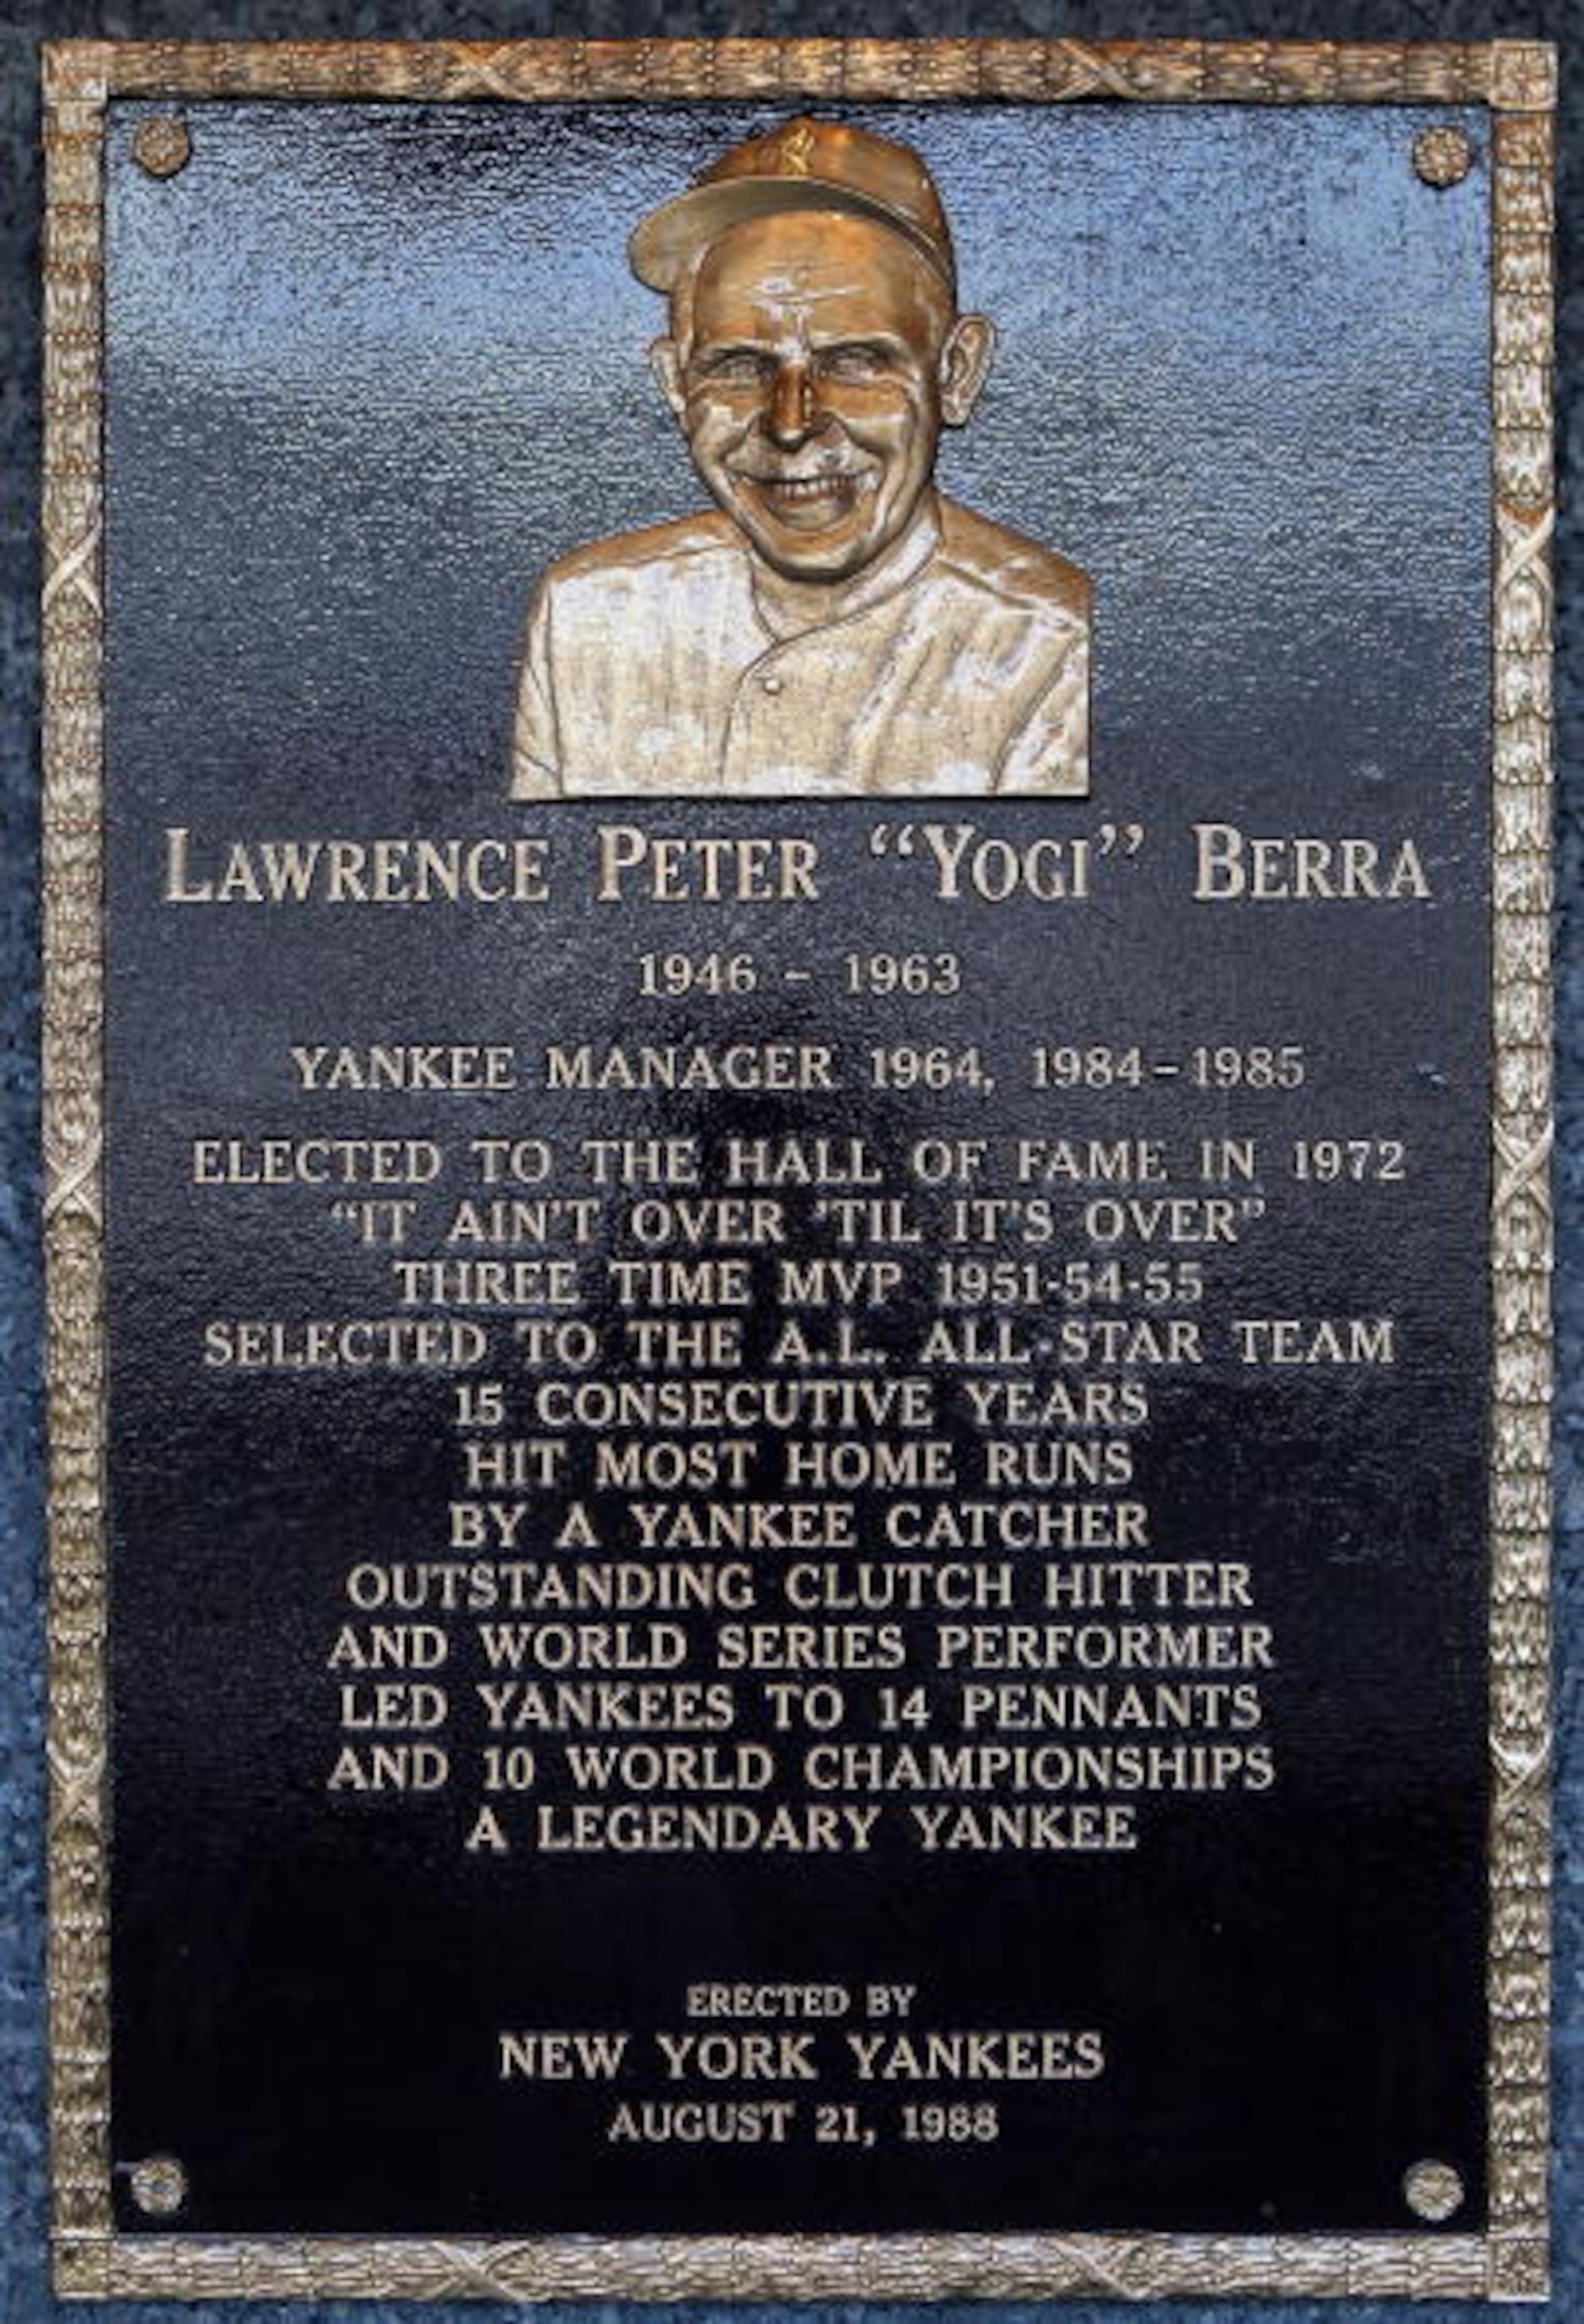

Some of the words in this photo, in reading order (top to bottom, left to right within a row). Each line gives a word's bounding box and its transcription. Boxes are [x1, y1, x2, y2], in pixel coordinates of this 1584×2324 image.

[165, 827, 549, 902] LAWRENCE
[598, 826, 819, 900] PETER
[1194, 824, 1431, 899] BERRA
[639, 953, 756, 995] 1946
[846, 953, 960, 995] 1963
[291, 1046, 516, 1091] YANKEE
[546, 1046, 835, 1090] MANAGER
[871, 1047, 994, 1095] 1964,
[194, 1140, 442, 1184] ELECTED
[470, 1140, 552, 1184] TO
[582, 1139, 697, 1184] THE
[728, 1139, 882, 1185] HALL
[913, 1139, 987, 1185] OF
[1019, 1140, 1167, 1182] FAME
[1202, 1139, 1254, 1181] IN
[1295, 1141, 1405, 1180] 1972
[632, 1199, 785, 1246] OVER
[393, 1261, 579, 1305] THREE
[608, 1260, 750, 1306] TIME
[780, 1260, 902, 1307] MVP
[937, 1261, 1203, 1305] 1951-54-55
[205, 1321, 486, 1370] SELECTED
[515, 1320, 596, 1370] TO
[627, 1320, 741, 1367] THE
[770, 1318, 887, 1367] A.L.
[919, 1319, 1202, 1365] ALL-STAR
[1232, 1319, 1393, 1363] TEAM
[455, 1383, 505, 1426] 15
[536, 1380, 932, 1428] CONSECUTIVE
[965, 1381, 1148, 1427] YEARS
[464, 1440, 566, 1489] HIT
[596, 1441, 757, 1489] MOST
[787, 1441, 956, 1488] HOME
[987, 1440, 1133, 1487] RUNS
[449, 1503, 527, 1548] BY
[555, 1502, 598, 1548] A
[629, 1503, 856, 1548] YANKEE
[886, 1501, 1147, 1549] CATCHER
[347, 1562, 755, 1610] OUTSTANDING
[785, 1563, 1012, 1609] CLUTCH
[1046, 1561, 1254, 1608] HITTER
[327, 1625, 447, 1669] AND
[479, 1623, 686, 1670] WORLD
[718, 1624, 905, 1669] SERIES
[938, 1624, 1273, 1669] PERFORMER
[342, 1684, 447, 1729] LED
[476, 1683, 734, 1730] YANKEES
[765, 1684, 844, 1730] TO
[881, 1687, 931, 1729] 14
[963, 1684, 1261, 1729] PENNANTS
[328, 1745, 448, 1790] AND
[483, 1747, 535, 1791] 10
[565, 1745, 773, 1790] WORLD
[805, 1745, 1274, 1791] CHAMPIONSHIPS
[465, 1806, 507, 1851] A
[538, 1805, 880, 1851] LEGENDARY
[911, 1805, 1137, 1850] YANKEE
[687, 1984, 850, 2017] ERECTED
[867, 1985, 916, 2017] BY
[499, 2034, 627, 2079] NEW
[656, 2034, 817, 2080] YORK
[847, 2032, 1104, 2080] YANKEES
[608, 2102, 794, 2142] AUGUST
[816, 2106, 876, 2146] 21,
[903, 2104, 999, 2142] 1988
